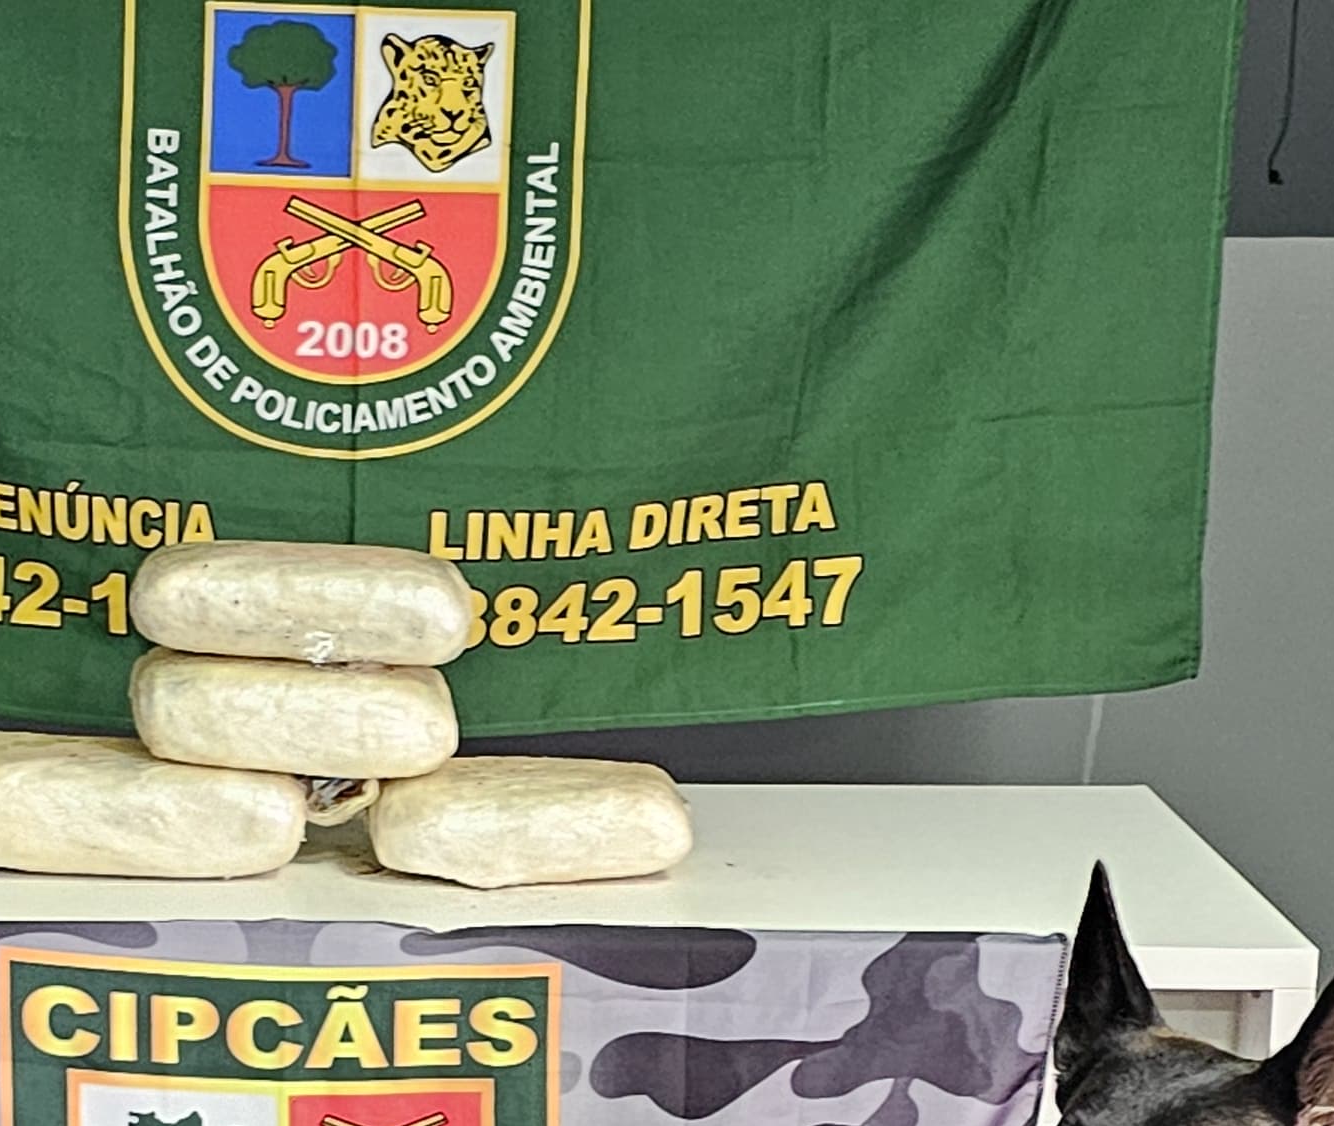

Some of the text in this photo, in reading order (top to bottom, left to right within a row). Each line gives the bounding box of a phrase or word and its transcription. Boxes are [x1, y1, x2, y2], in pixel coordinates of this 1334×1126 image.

[144, 127, 561, 434] BATALHÃO DE POLICIAMENTO AMBIENTAL
[295, 320, 409, 360] 2008
[429, 480, 837, 561] LINHA DIRETA
[466, 555, 864, 649] 842-1547
[20, 984, 539, 1070] CIPCÃES
